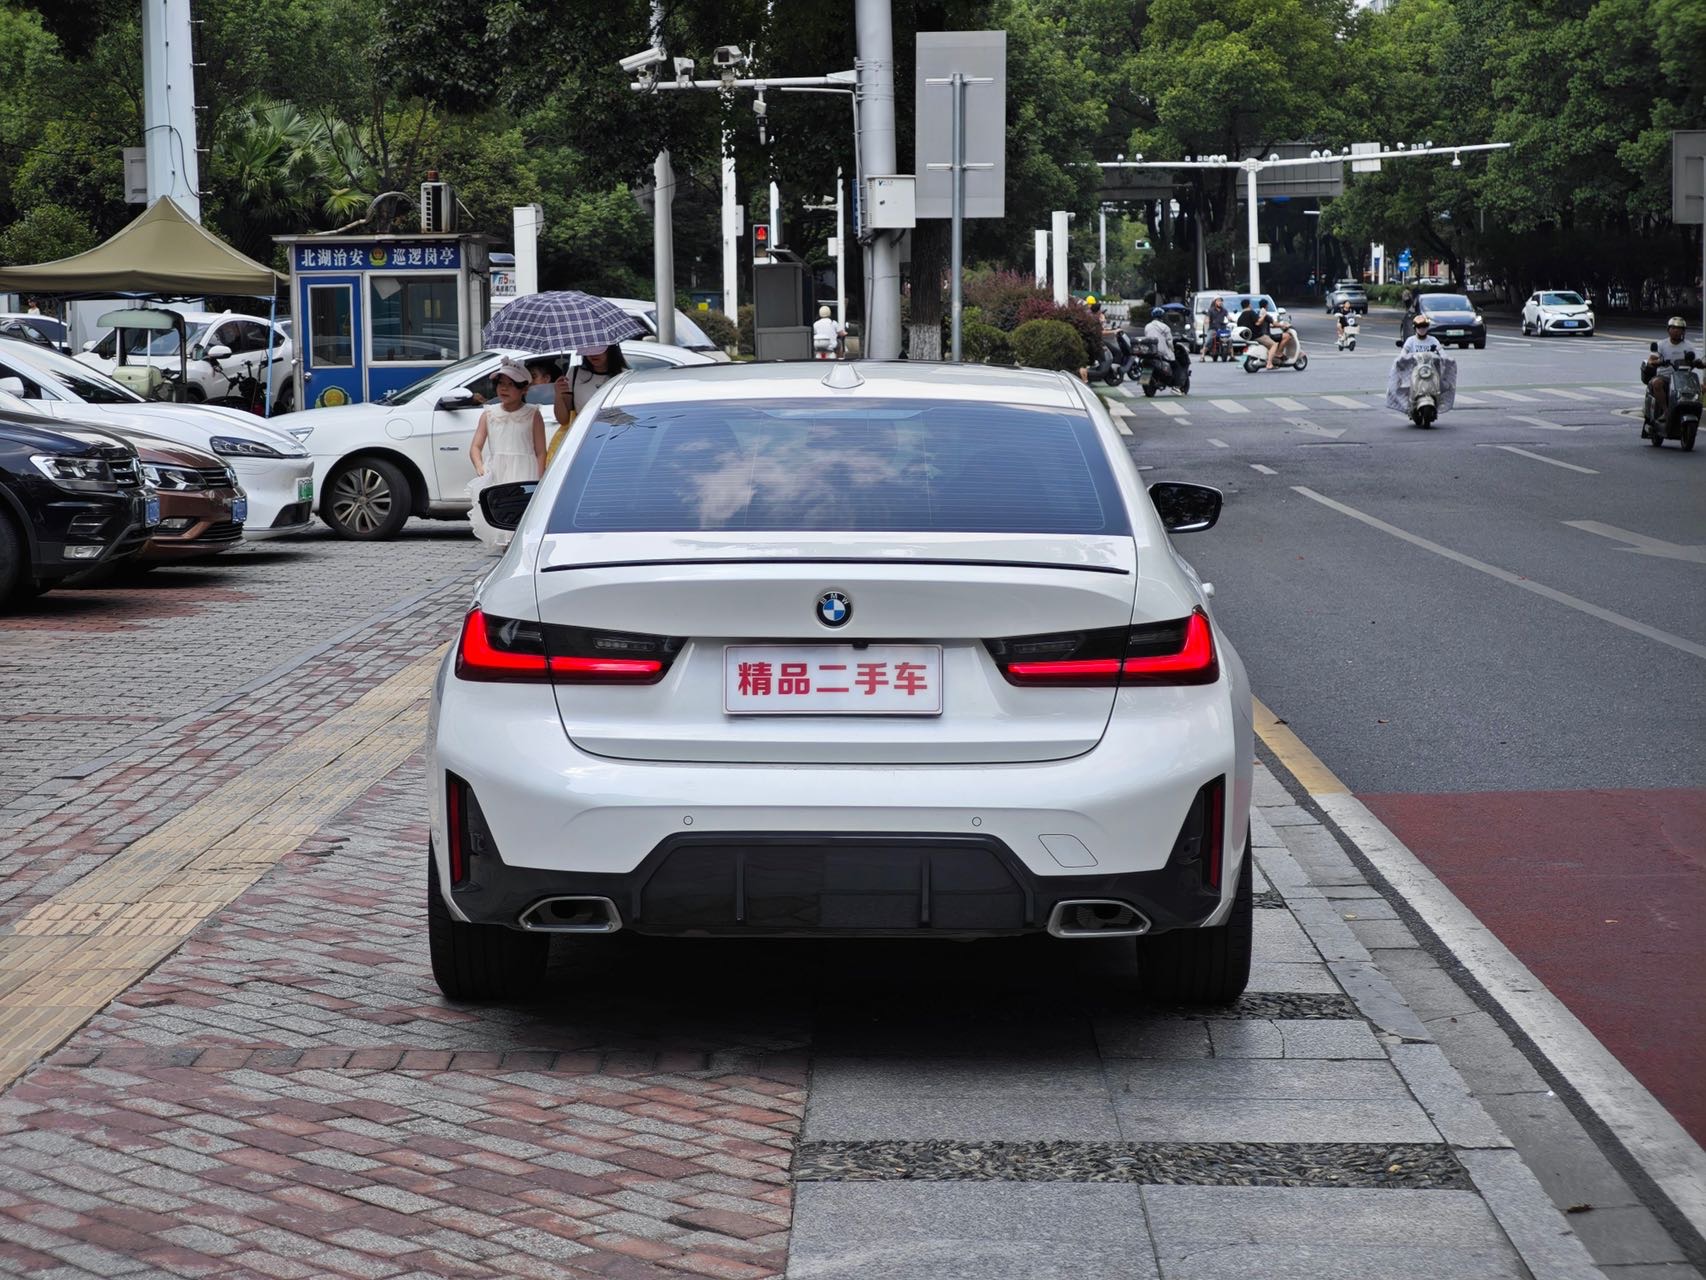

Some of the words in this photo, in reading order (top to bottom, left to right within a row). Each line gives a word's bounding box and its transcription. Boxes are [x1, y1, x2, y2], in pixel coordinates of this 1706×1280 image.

[301, 249, 363, 266] 北湖治安
[392, 247, 455, 266] 巡逻岗亭
[738, 662, 928, 696] 精品二手车
